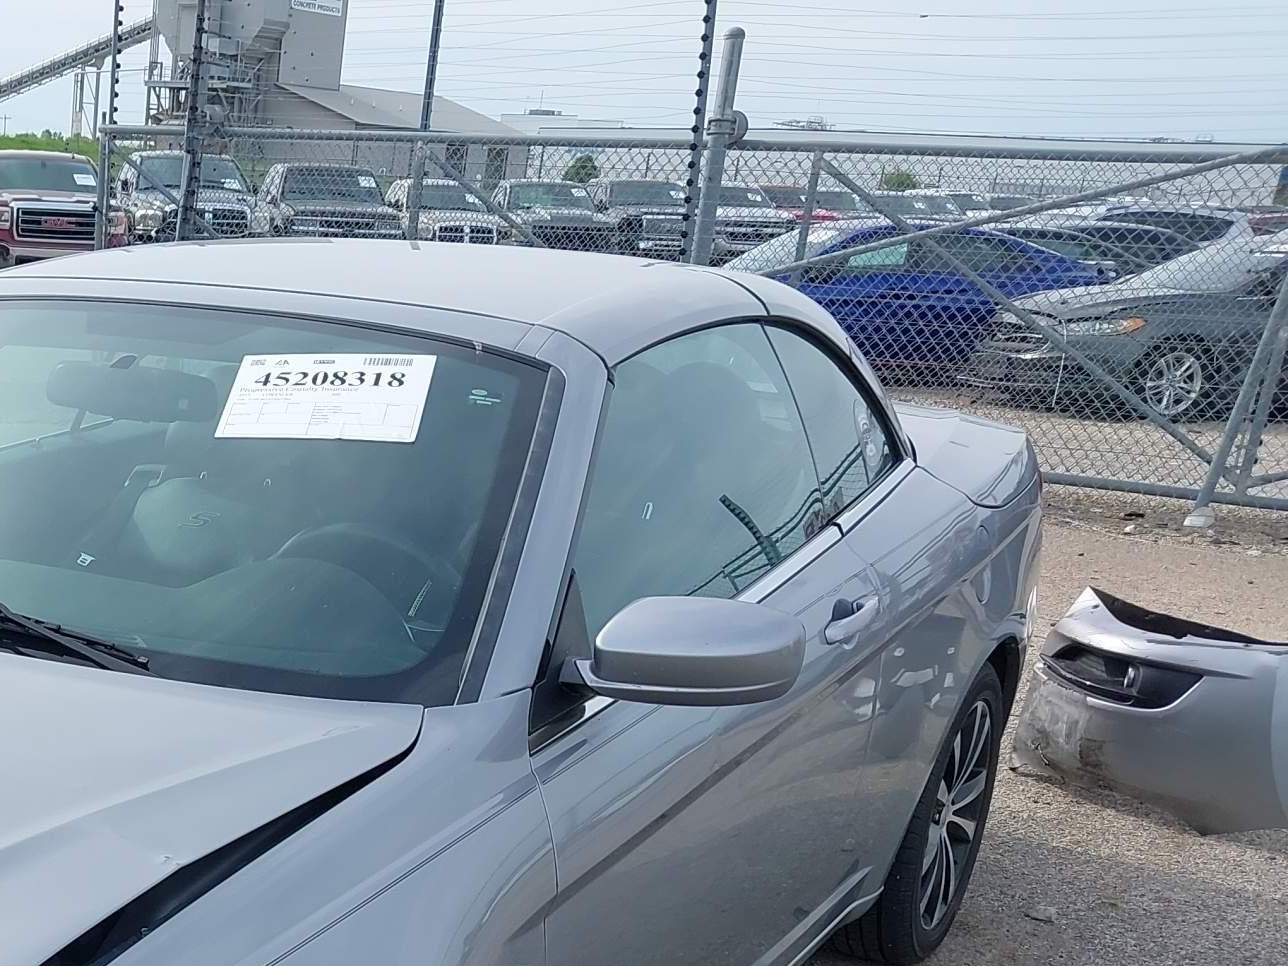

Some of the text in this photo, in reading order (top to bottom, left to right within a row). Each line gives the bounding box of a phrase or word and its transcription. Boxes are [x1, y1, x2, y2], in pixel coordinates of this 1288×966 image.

[293, 0, 341, 14] CONCRETE PRODUCTS
[254, 370, 406, 388] 45208318
